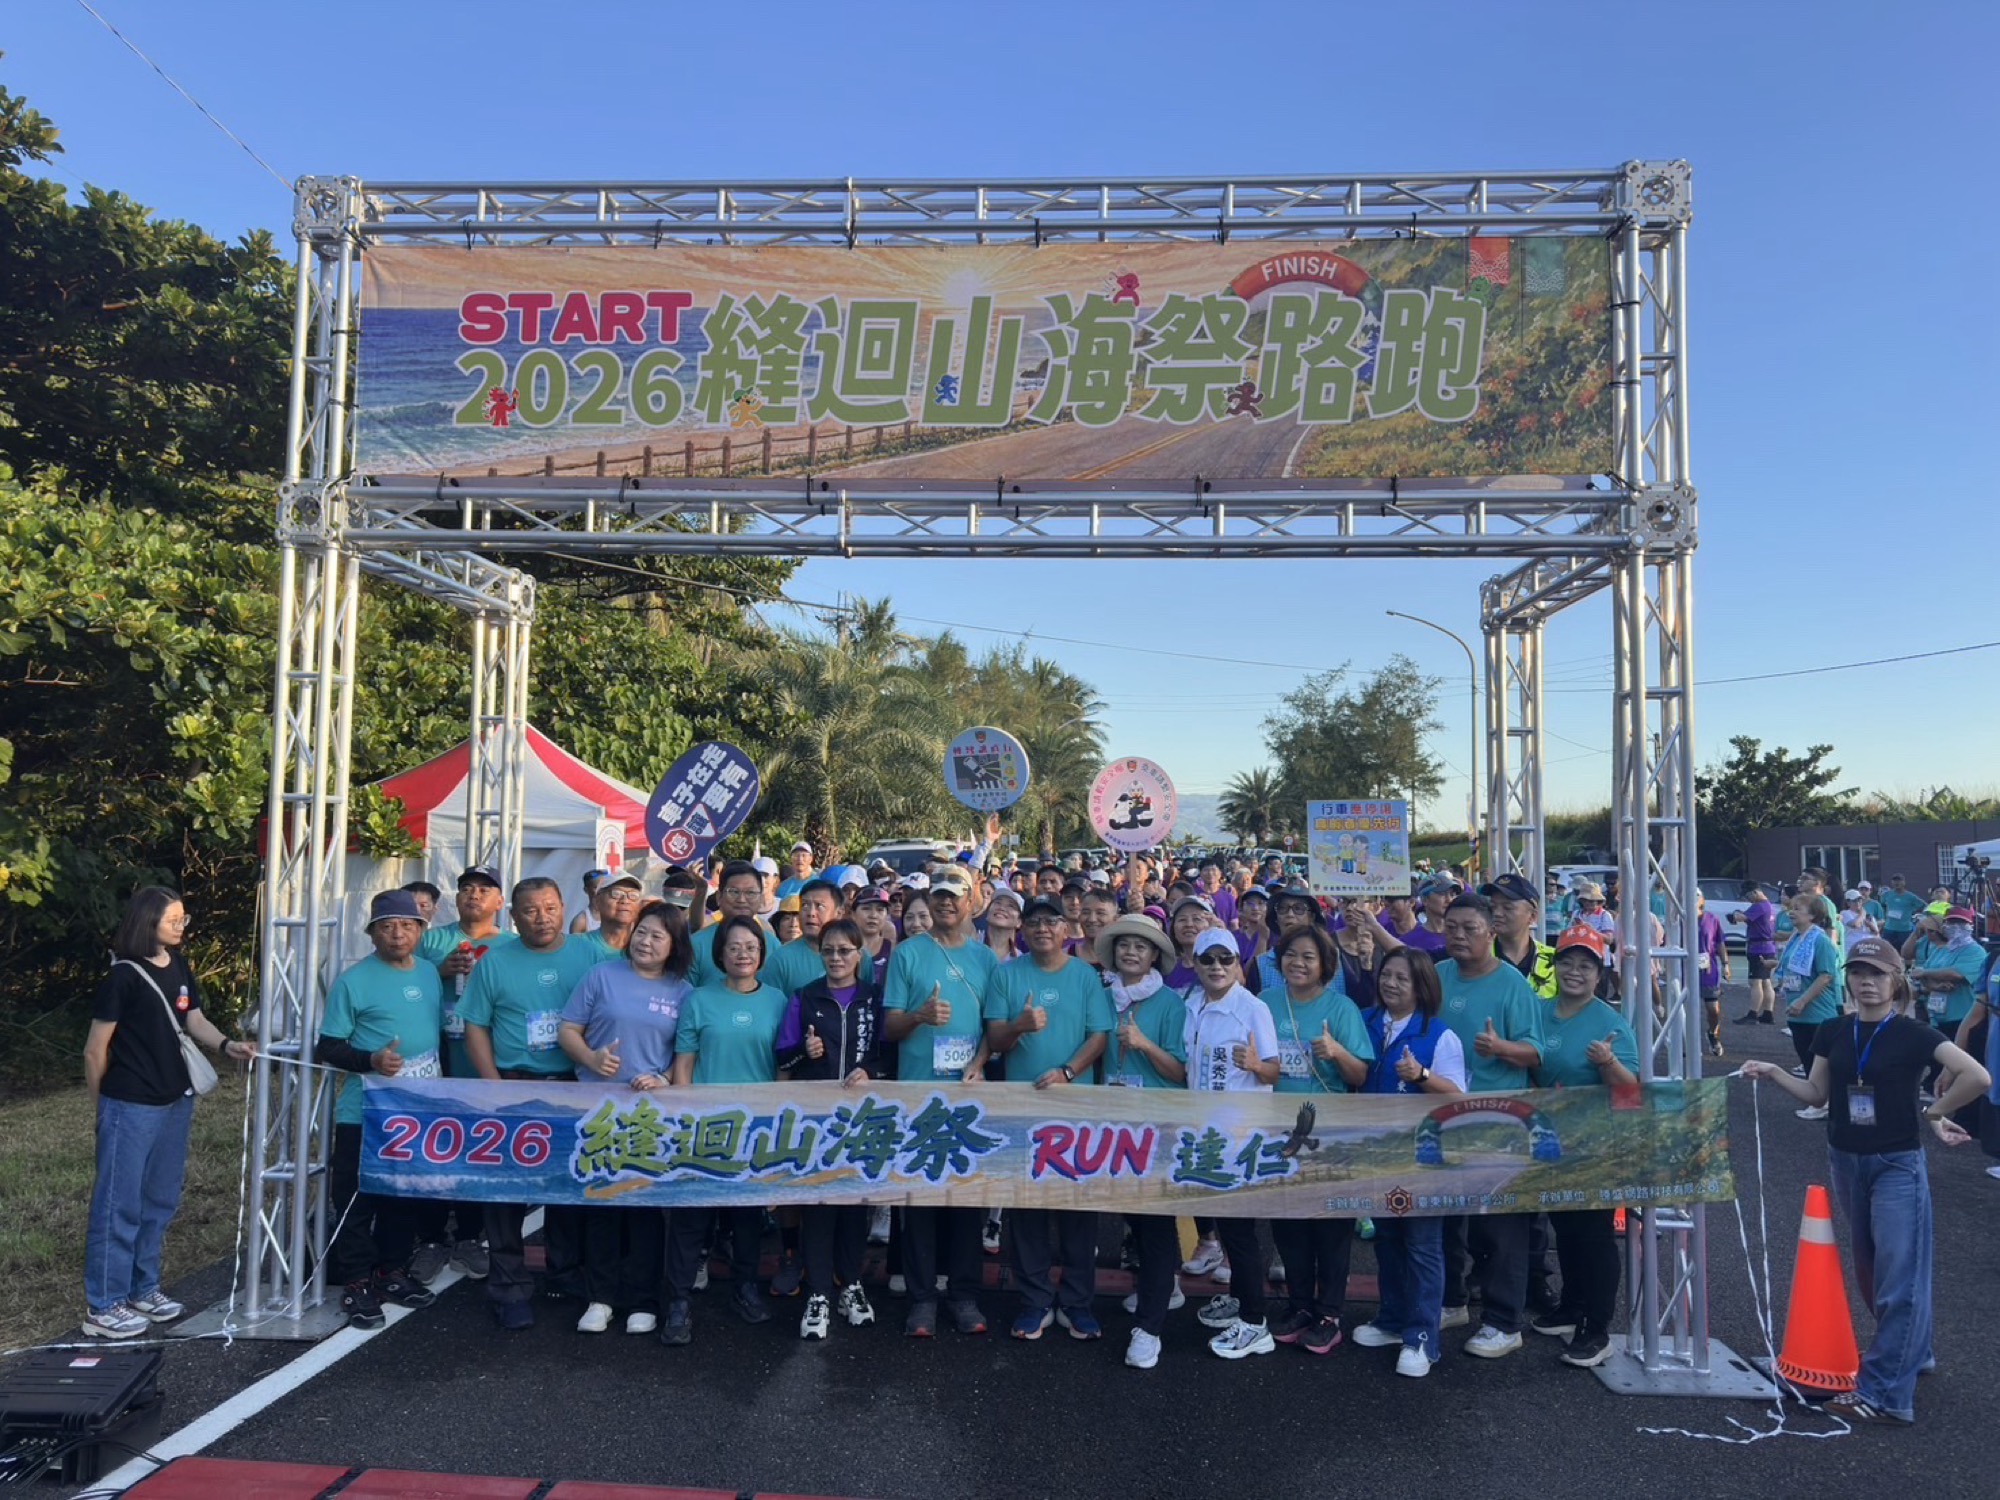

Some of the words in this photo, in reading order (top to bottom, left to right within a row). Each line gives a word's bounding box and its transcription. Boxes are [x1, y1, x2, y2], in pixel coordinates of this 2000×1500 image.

[1260, 258, 1339, 281] FINISH
[459, 290, 693, 345] START
[453, 347, 686, 428] 2026
[693, 287, 1488, 429] 縫迴山海祭路跑
[657, 743, 728, 826] 車子在走
[668, 833, 689, 855] 停
[701, 759, 749, 814] 要有
[944, 1049, 972, 1062] 5069
[1453, 1099, 1512, 1112] FINISH
[378, 1115, 553, 1166] 2026
[571, 1093, 1004, 1182] 縫迴山海祭
[1031, 1123, 1156, 1181] RUN
[1172, 1125, 1296, 1188] 達仁
